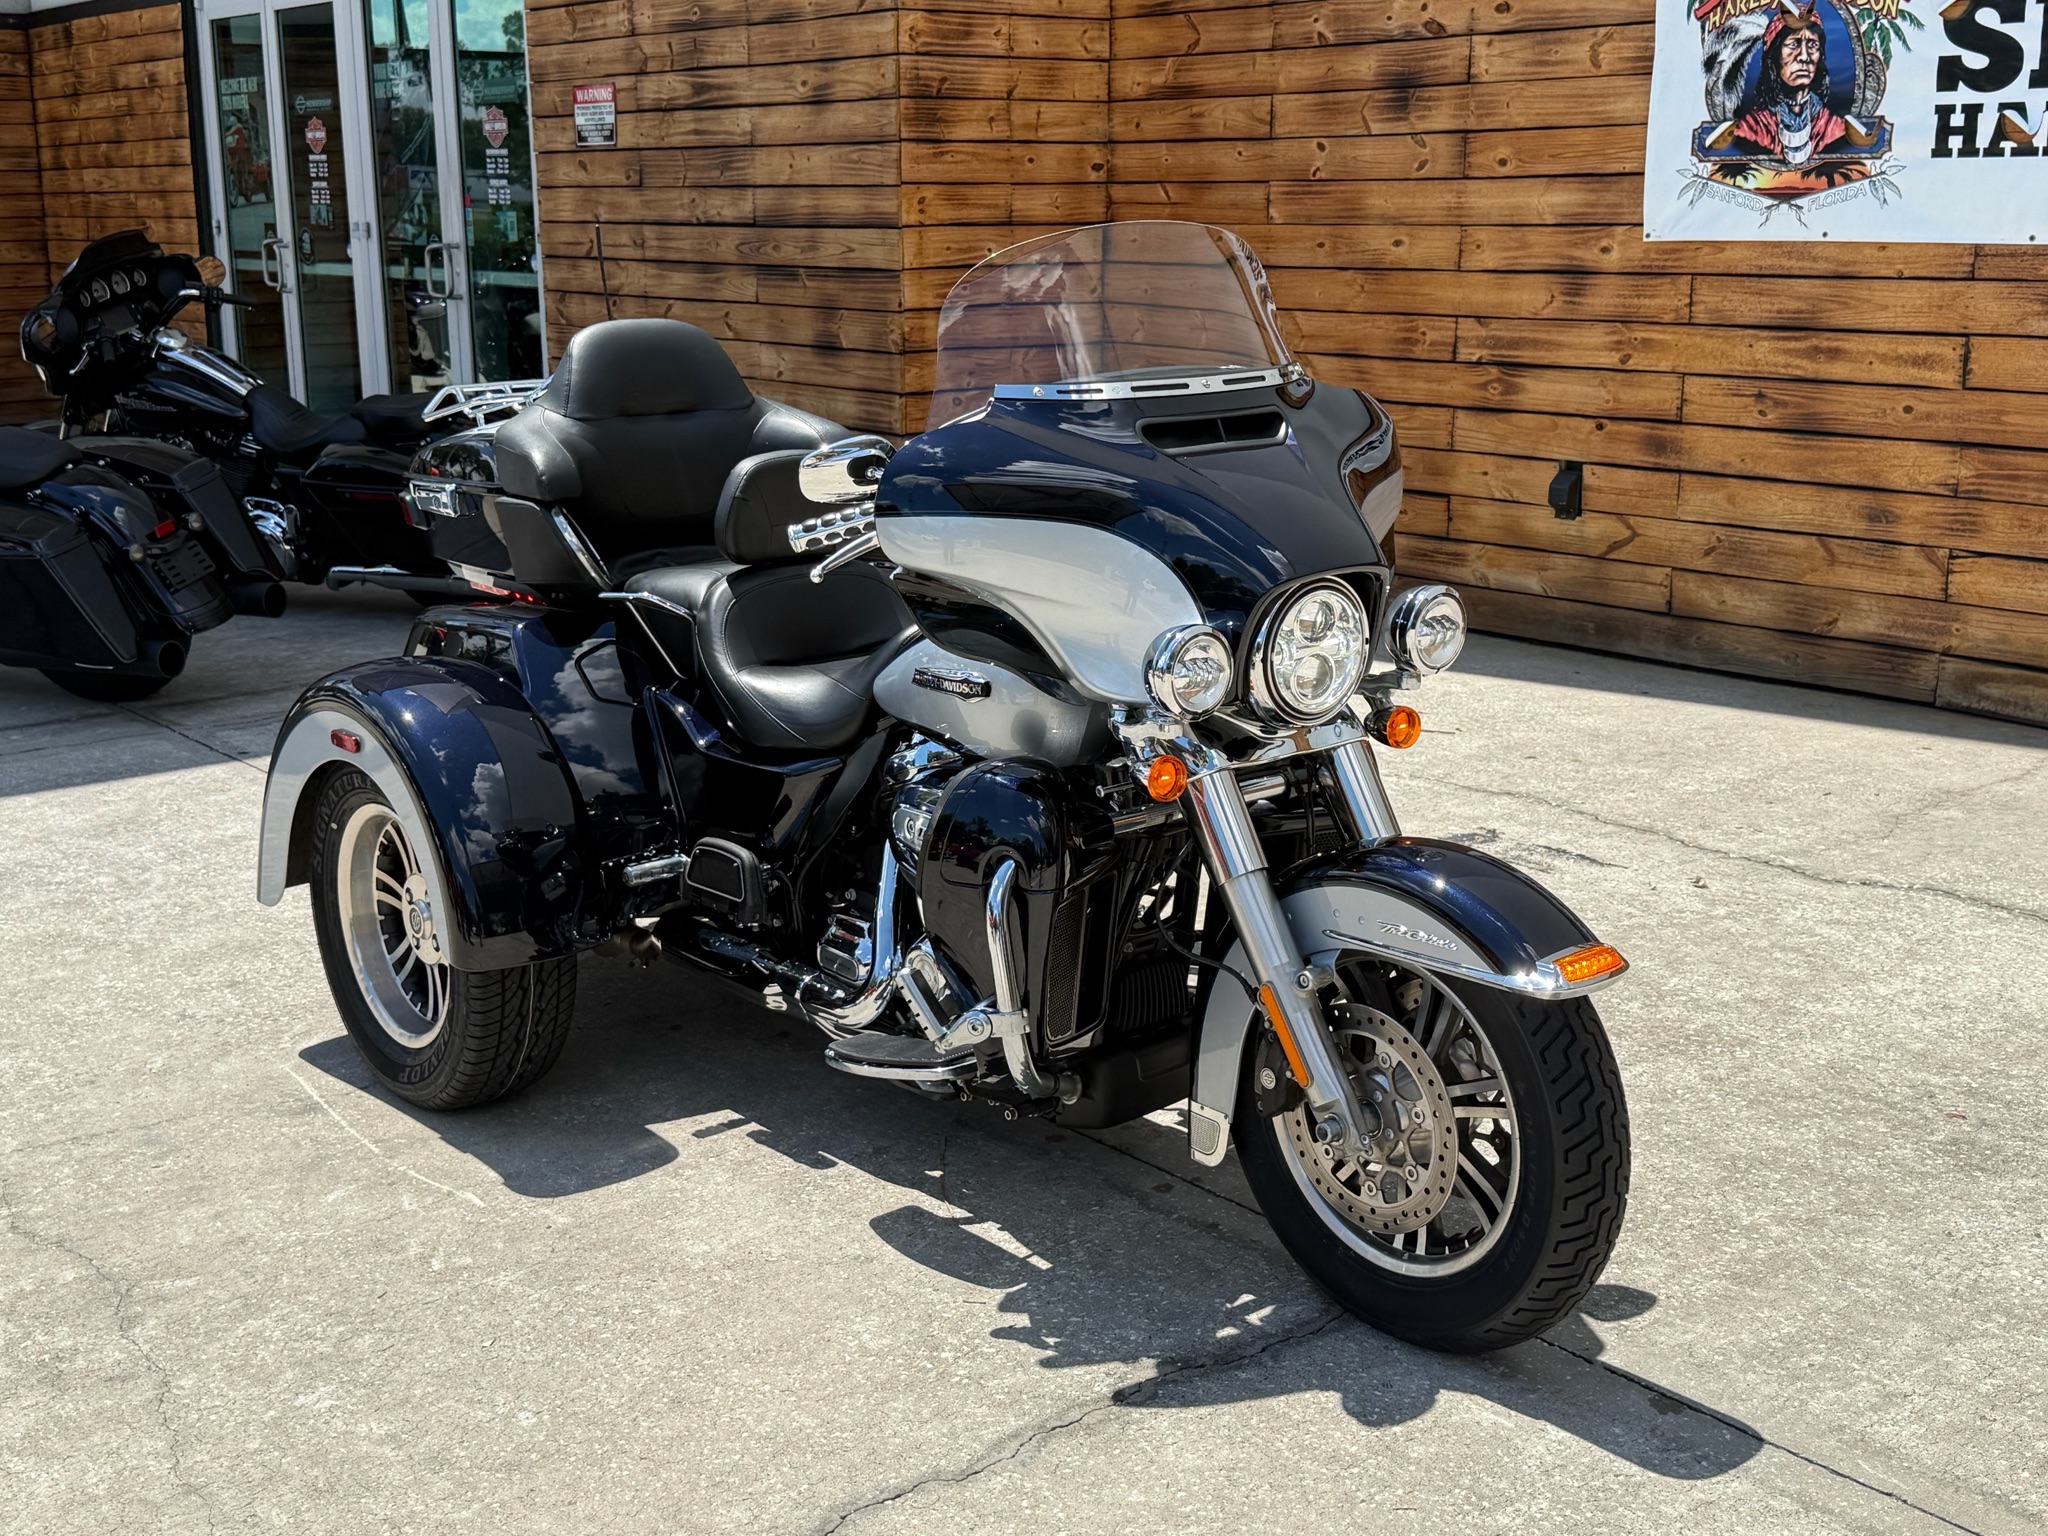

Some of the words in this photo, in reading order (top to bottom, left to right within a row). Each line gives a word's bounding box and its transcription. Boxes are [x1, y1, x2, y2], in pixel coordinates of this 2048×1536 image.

[1936, 0, 2048, 93] S
[576, 88, 612, 102] WARNING
[1931, 101, 2048, 158] HA
[1706, 182, 1765, 216] SANFORD,
[1807, 183, 1867, 212] FLORIDA
[914, 674, 982, 695] LEY-DAVIDSON
[313, 773, 375, 875] SIGNATURE
[398, 1018, 450, 1083] DUNLOP
